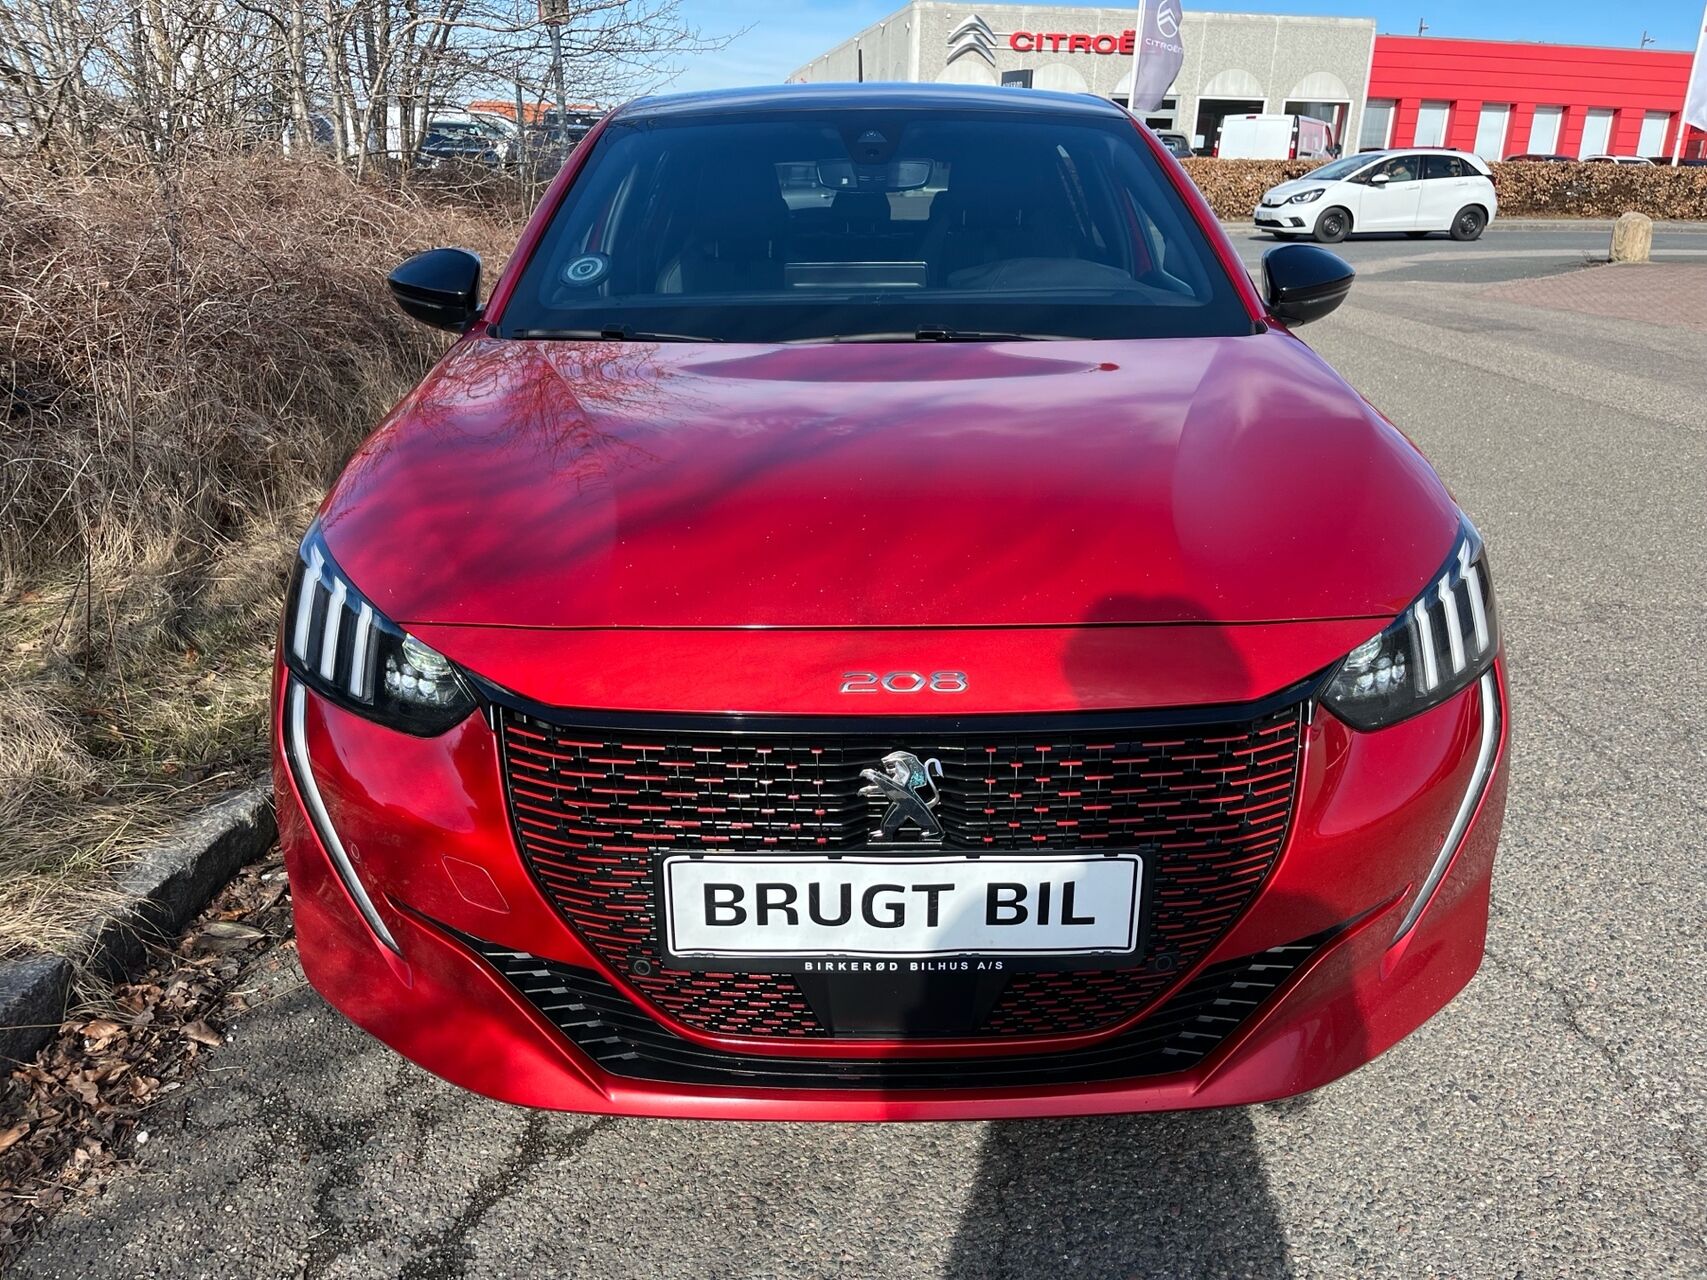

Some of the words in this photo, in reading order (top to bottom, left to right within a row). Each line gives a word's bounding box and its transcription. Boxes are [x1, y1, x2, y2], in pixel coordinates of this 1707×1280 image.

[1010, 30, 1136, 55] CITROË
[839, 670, 968, 693] 208
[703, 882, 955, 928] BRUGT
[985, 881, 1095, 925] BIL
[804, 961, 898, 972] BIRKERØD
[909, 961, 969, 972] BILHUS
[977, 961, 1004, 971] A/S
